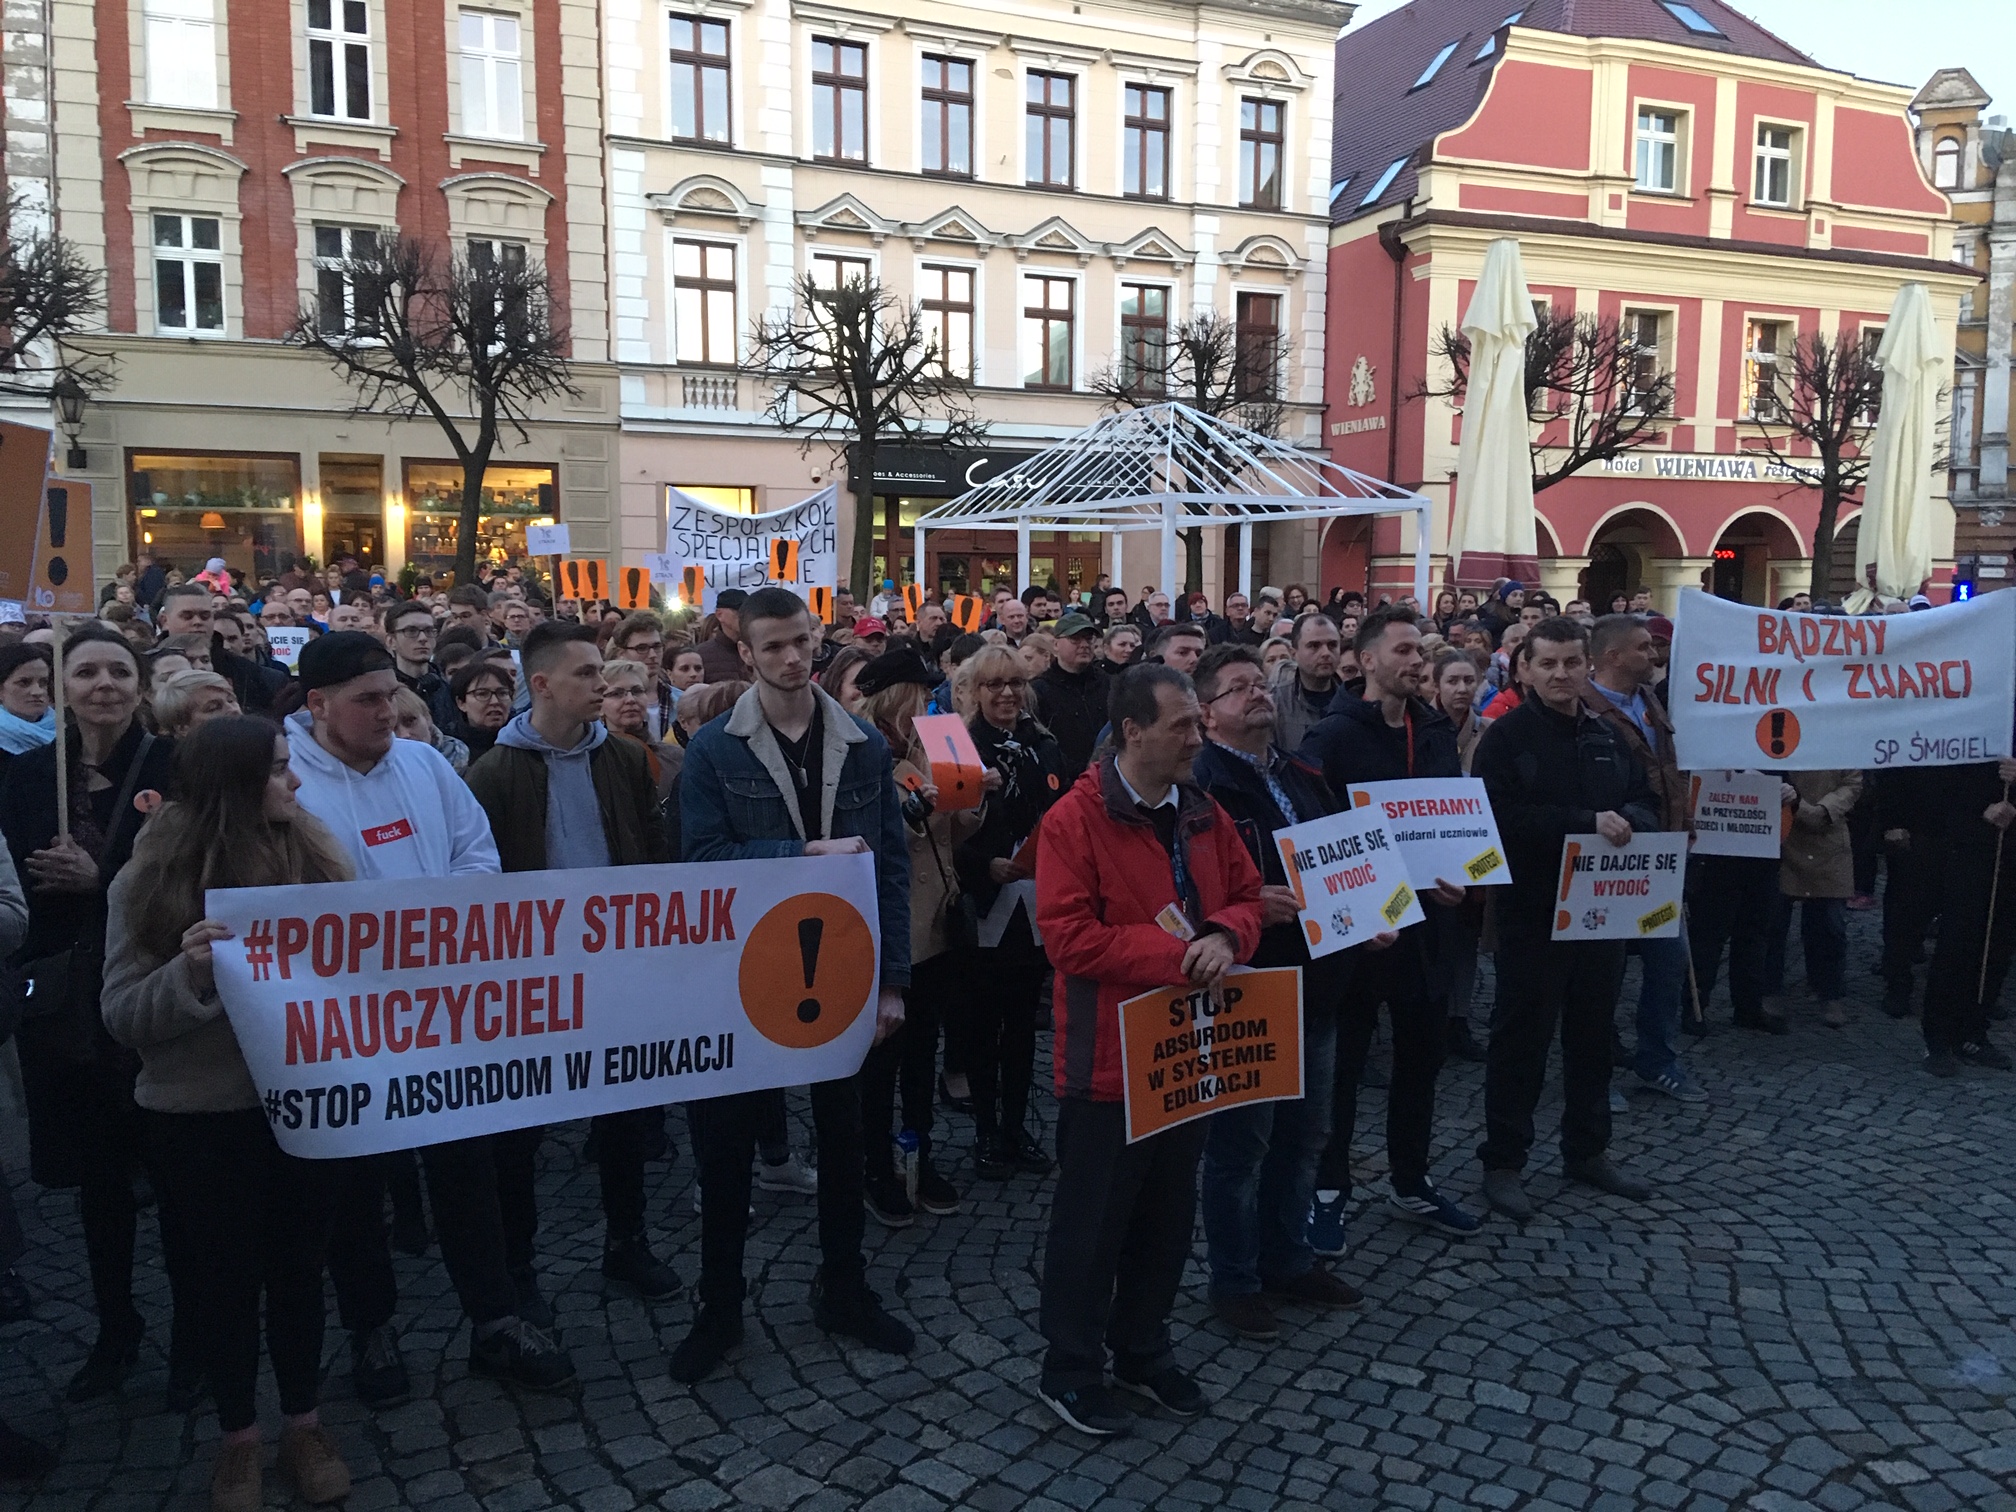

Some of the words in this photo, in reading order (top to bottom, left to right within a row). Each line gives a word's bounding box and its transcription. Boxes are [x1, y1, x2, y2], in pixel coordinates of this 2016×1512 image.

[1331, 416, 1386, 436] WIENIAWA
[1655, 457, 1757, 479] WIENIAWA
[675, 529, 836, 561] SPECJALYCH
[1695, 662, 1781, 705] SILNI
[1842, 660, 1972, 699] ZWARCI
[1874, 739, 1899, 764] SP
[1909, 731, 1997, 763] ŚMIGIEL
[1381, 798, 1482, 819] SPIERAMY!
[1701, 806, 1711, 816] NA
[1713, 807, 1766, 820] PRZYSZŁOŚCI
[1709, 791, 1735, 804] ZALEŻY
[376, 826, 402, 841] fuck
[1394, 828, 1436, 842] olidarni
[1439, 827, 1488, 839] uczniowie
[1727, 822, 1772, 835] MŁODZIEŻY
[1291, 849, 1317, 873] NIE
[1320, 835, 1364, 866] DAJCIE
[1365, 828, 1390, 851] SIĘ
[1572, 855, 1594, 872] NIE
[1600, 854, 1650, 872] DAJCIE
[1655, 853, 1677, 874] SIĘ
[1323, 857, 1376, 896] WYDOIĆ
[1593, 875, 1650, 896] WYDOIĆ
[244, 898, 566, 982] #POPIERAMY
[581, 887, 738, 953] STRAJK
[285, 972, 585, 1066] NAUCZYCIELI
[1169, 987, 1243, 1027] STOP
[1153, 1018, 1268, 1063] ABSURDOM
[265, 1083, 371, 1129] #STOP
[385, 1056, 552, 1120] ABSURDOM
[565, 1051, 592, 1091] W
[603, 1032, 734, 1085] EDUKACJI
[1147, 1068, 1165, 1091] W
[1172, 1043, 1276, 1082] SYSTEMIE
[1163, 1070, 1260, 1113] EDUKACJI
